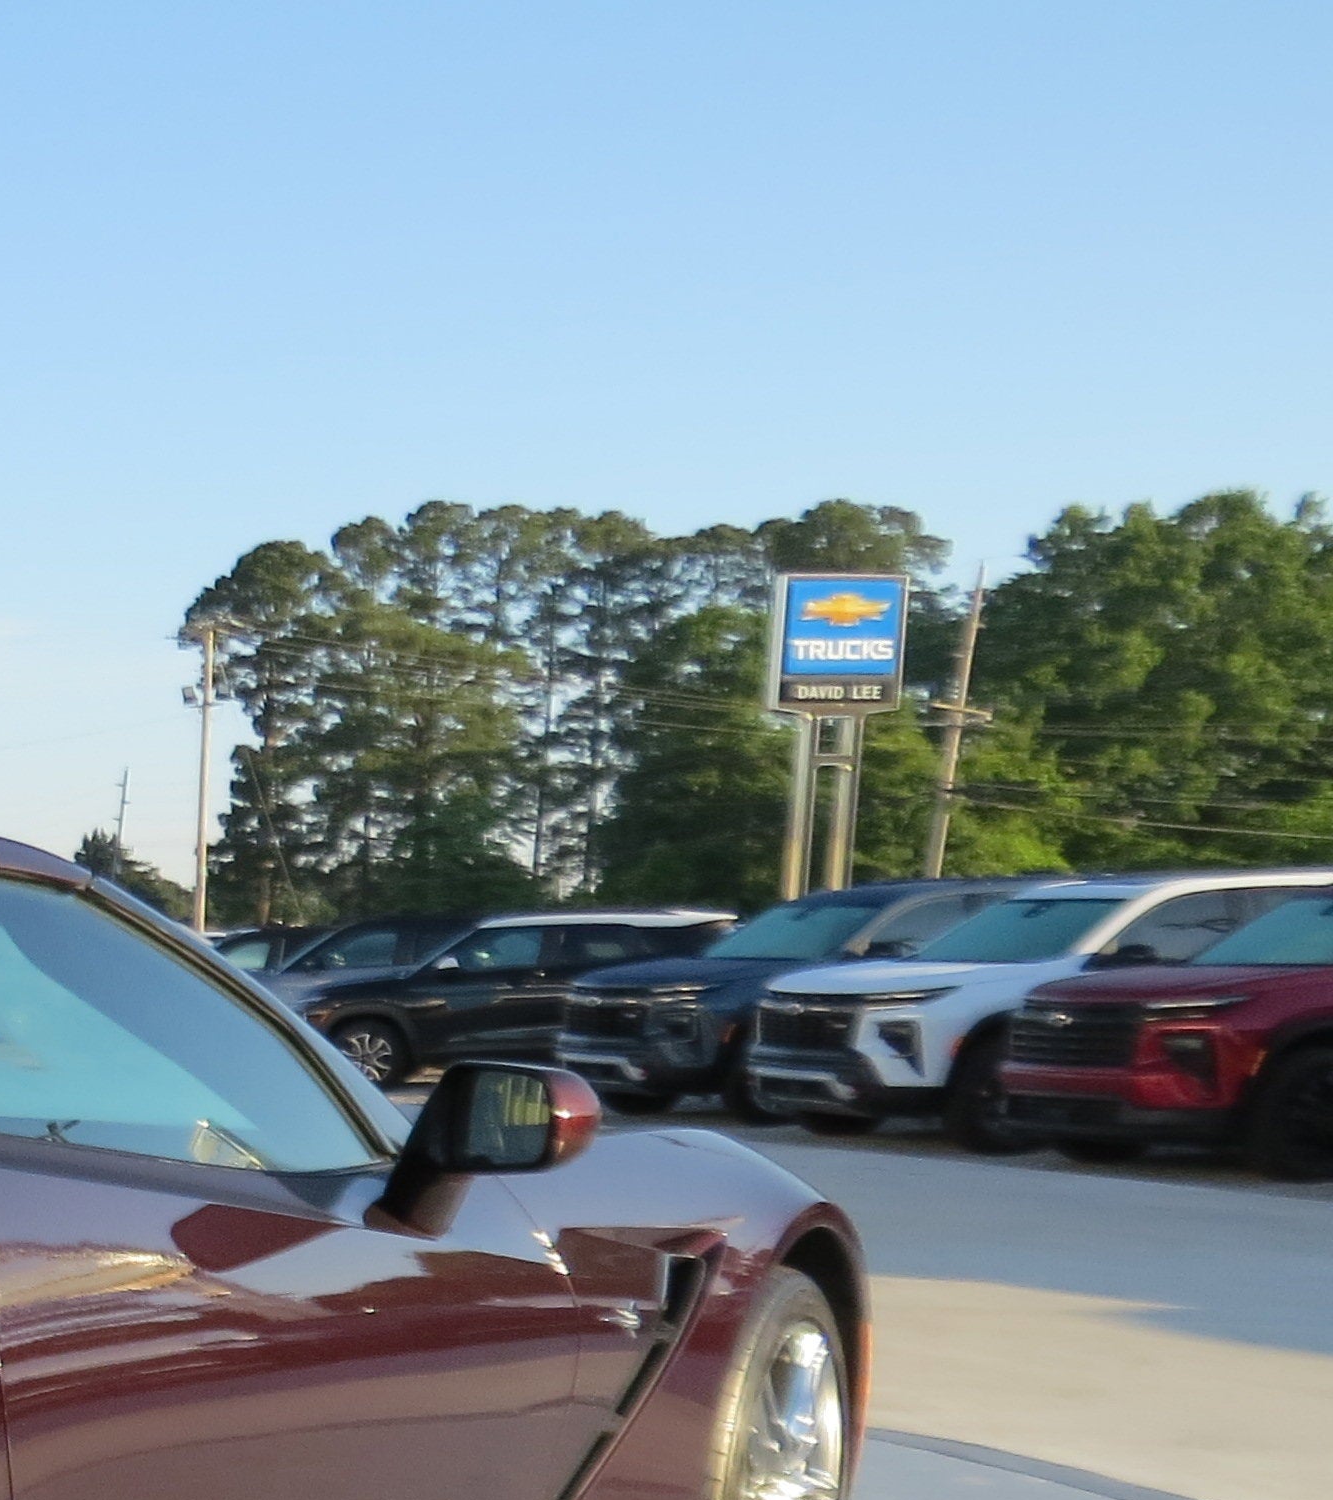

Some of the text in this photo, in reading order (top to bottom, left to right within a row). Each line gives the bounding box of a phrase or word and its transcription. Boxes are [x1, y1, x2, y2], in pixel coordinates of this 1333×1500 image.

[791, 638, 895, 660] TRUCKS
[797, 686, 883, 700] DAVID LEE
